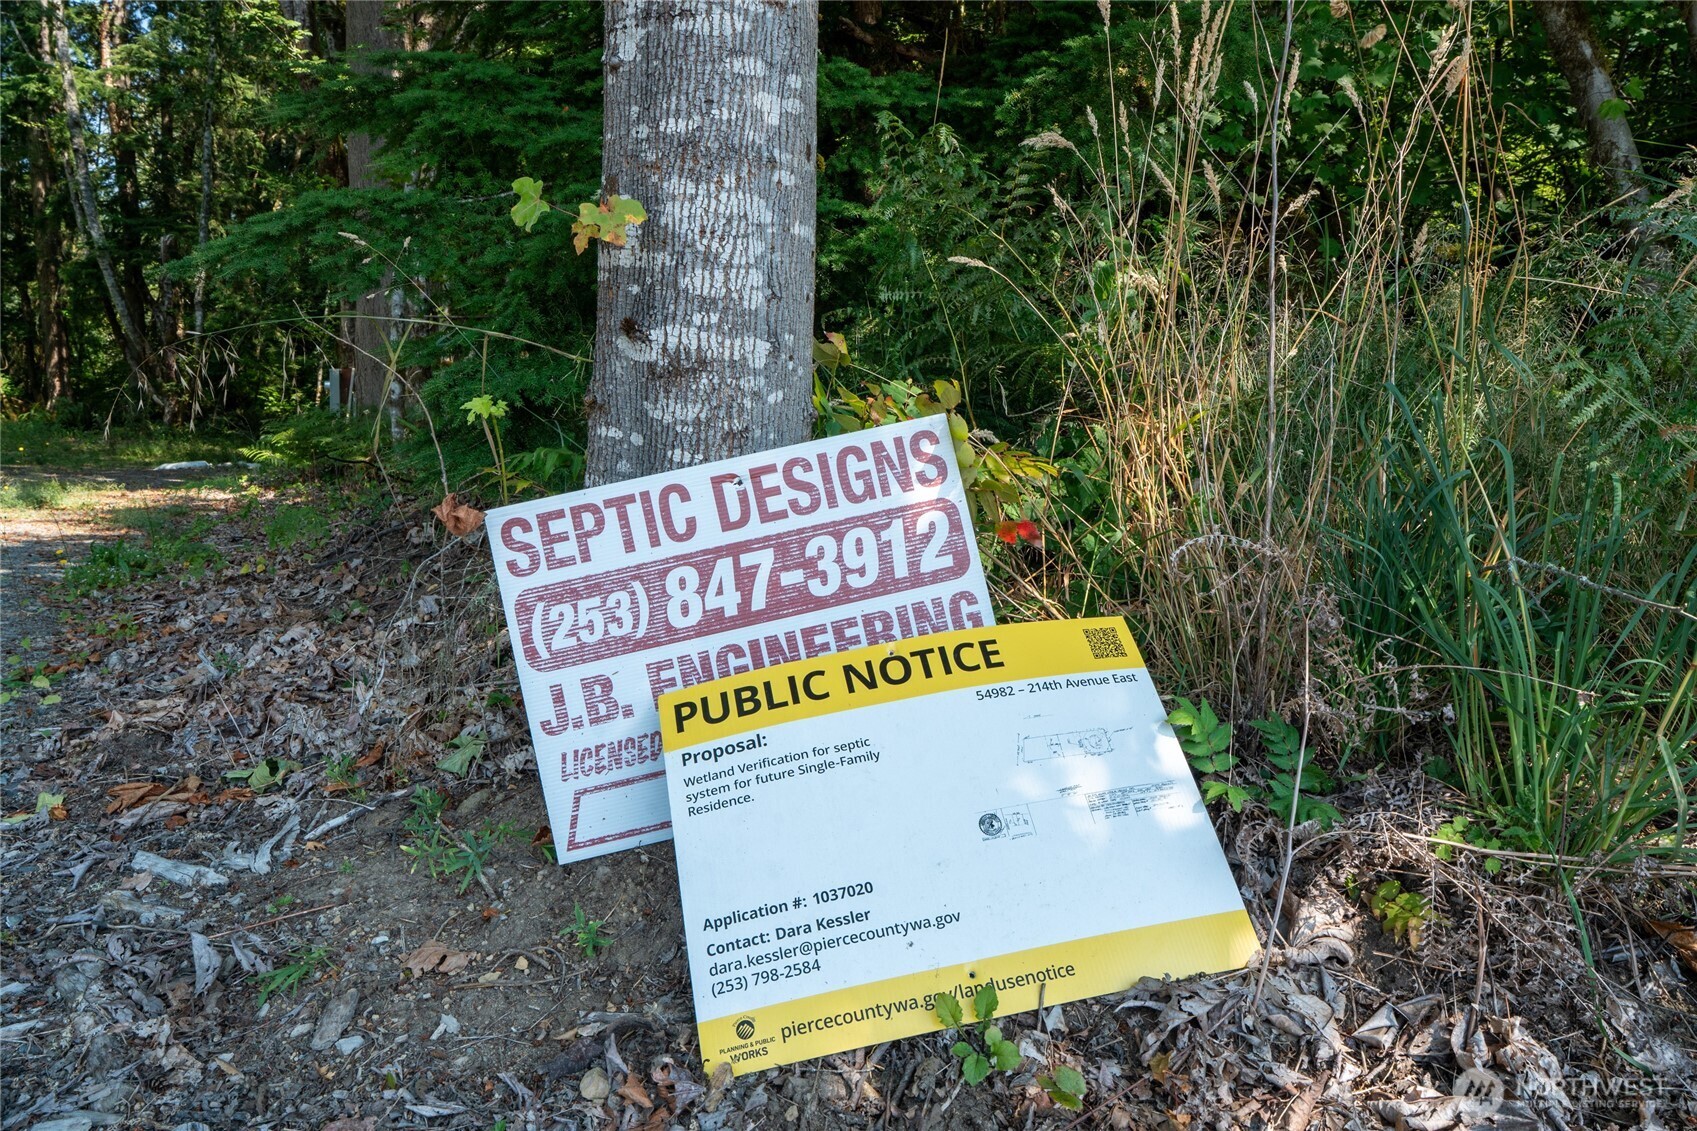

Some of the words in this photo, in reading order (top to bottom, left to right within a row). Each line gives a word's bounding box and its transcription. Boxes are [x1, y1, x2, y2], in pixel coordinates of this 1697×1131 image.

[500, 483, 697, 578] SEPTIC
[710, 430, 948, 532] DESIGNS
[531, 581, 650, 659] (253)
[665, 510, 954, 629] 847-3912
[539, 674, 635, 737] J.B.
[645, 590, 984, 711] ENGINEERING
[673, 670, 830, 733] PUBLIC
[842, 639, 1005, 694] NOTICE
[976, 686, 1016, 701] 54982
[1028, 680, 1063, 694] 214th
[1065, 676, 1110, 689] Avenue
[1111, 673, 1138, 684] East
[560, 730, 664, 782] LICENSED
[681, 733, 768, 767] Proposal:
[683, 766, 735, 787] Wetland
[737, 750, 809, 774] Verification
[812, 745, 831, 758] for
[833, 737, 871, 753] septic
[685, 784, 731, 803] system
[733, 777, 752, 789] for
[755, 768, 795, 785] future
[798, 750, 880, 776] Single-Family
[687, 793, 755, 817] Residence.
[703, 902, 789, 932] Application
[792, 897, 808, 910] #:
[812, 881, 874, 904] 1037020
[706, 932, 771, 957] Contact:
[775, 923, 812, 941] Dara
[816, 909, 871, 931] Kessler
[709, 911, 961, 976] dara.kessler@piercecountywa.gov
[711, 976, 748, 998] (253)
[751, 959, 821, 986] 798-2584
[781, 964, 1076, 1043] piercecountywa.g/landusenotice
[719, 1042, 749, 1055] PLANNING
[755, 1036, 776, 1047] PUBLIC
[730, 1047, 768, 1063] WORKS
